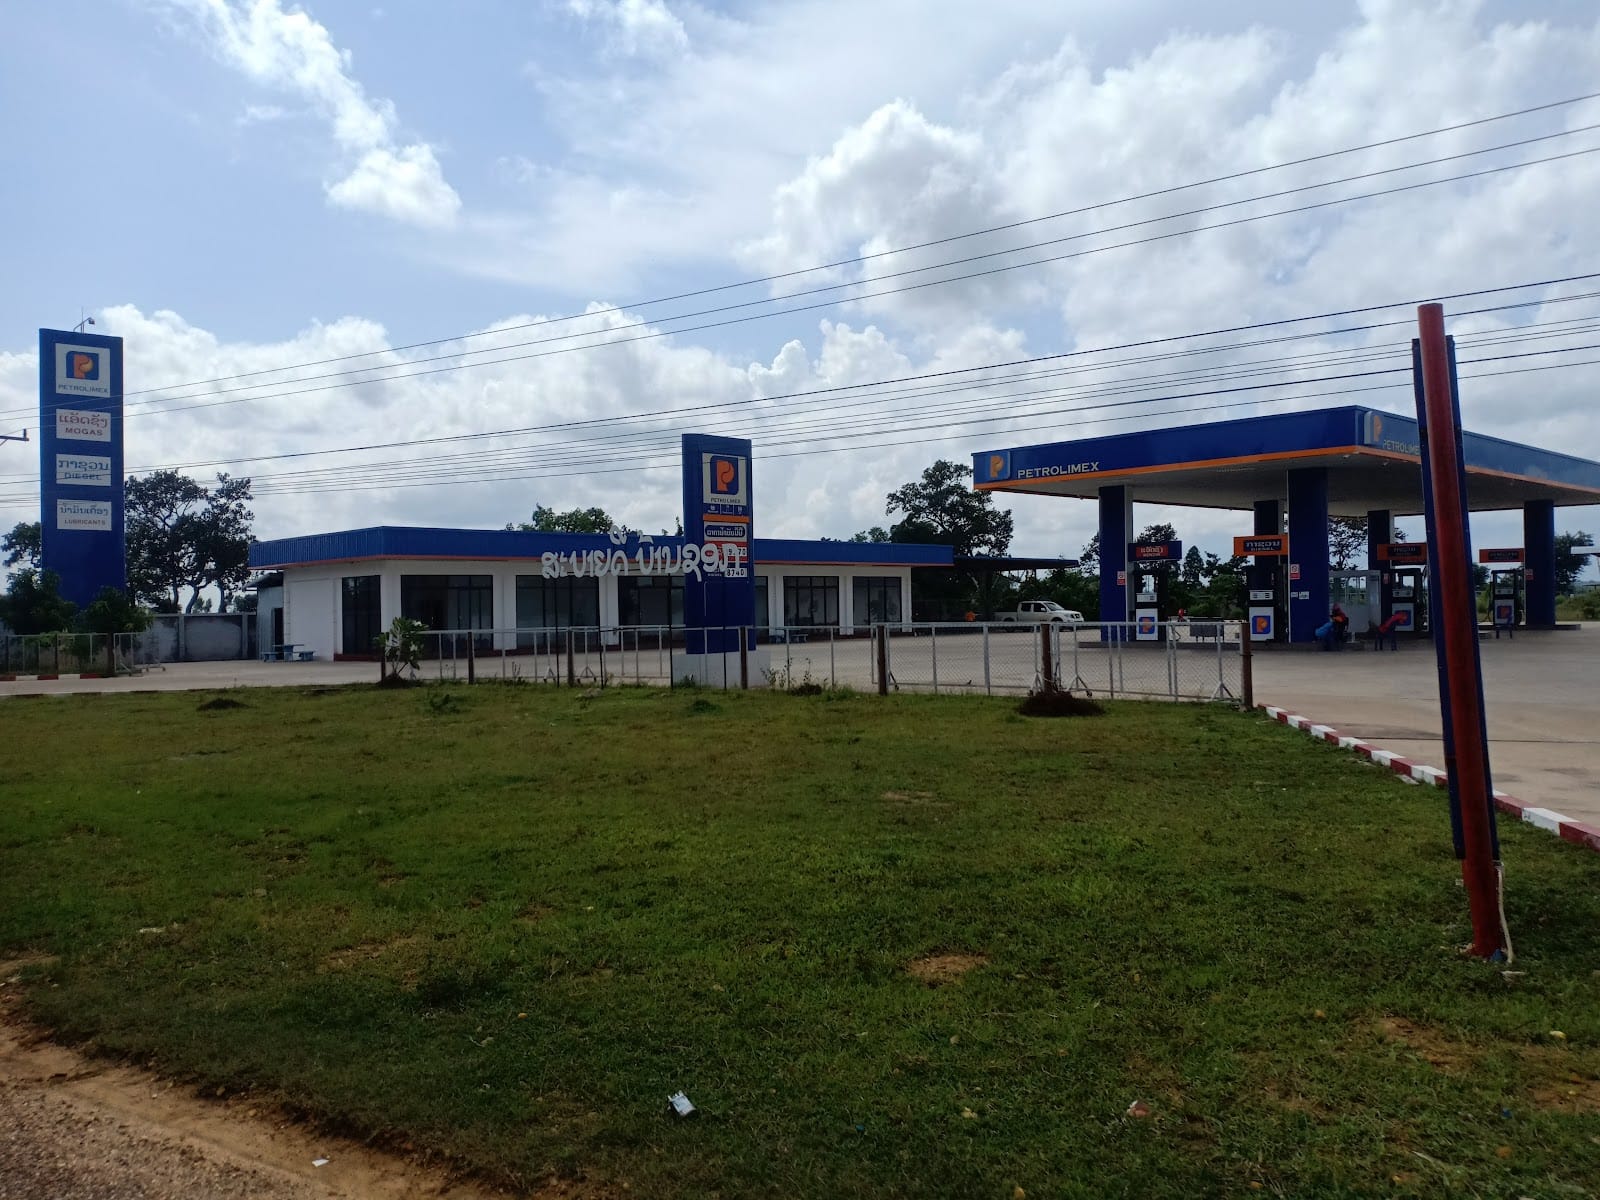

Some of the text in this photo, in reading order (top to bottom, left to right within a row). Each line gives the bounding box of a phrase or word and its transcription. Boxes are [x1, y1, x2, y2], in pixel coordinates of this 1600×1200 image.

[58, 383, 108, 394] PETROLIMEX
[65, 427, 103, 436] MOGAS
[1017, 461, 1100, 479] PETROLIMEX
[64, 472, 102, 481] DIESEL
